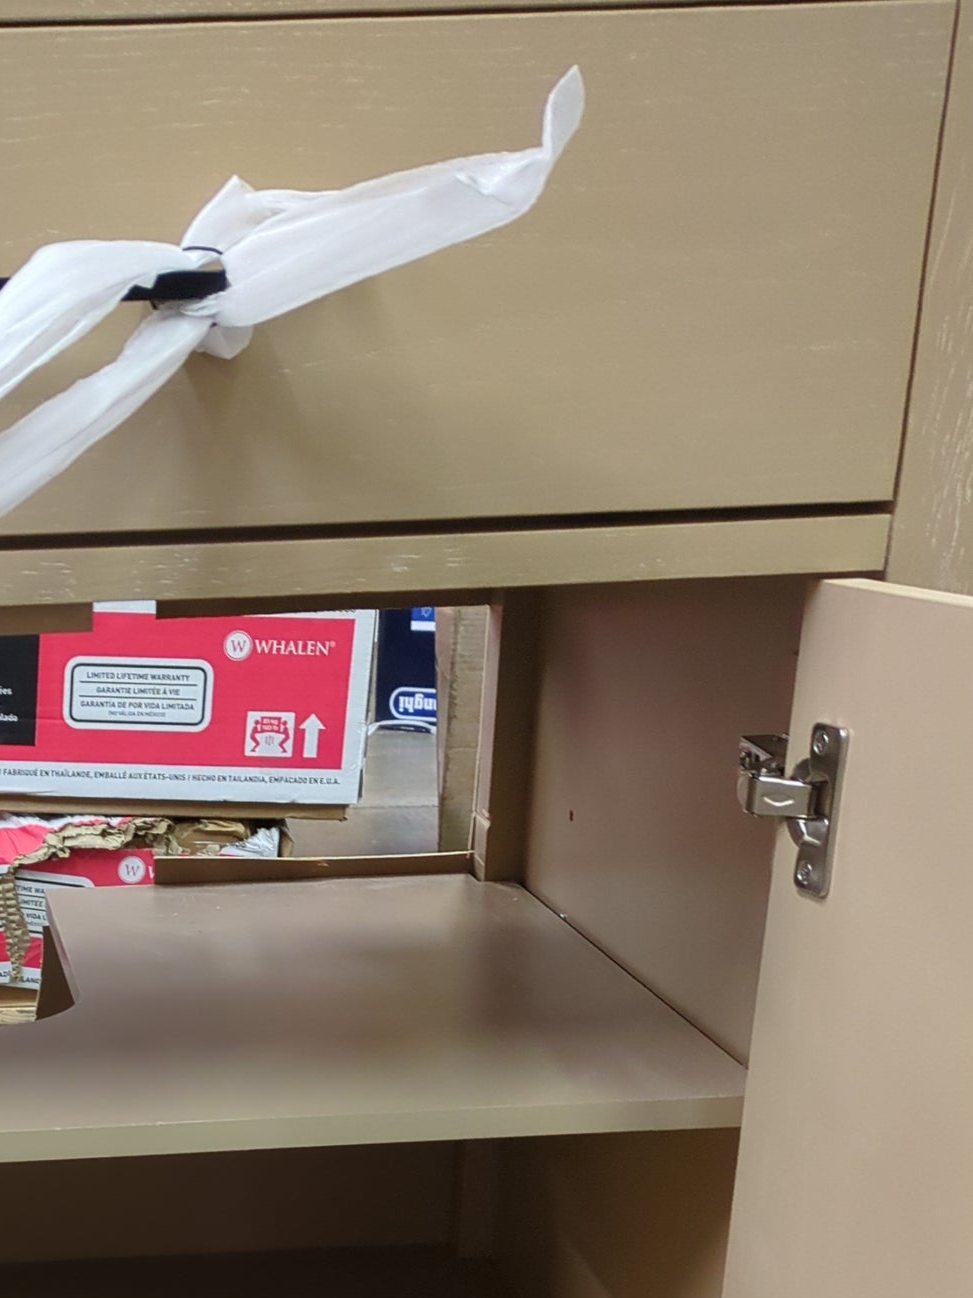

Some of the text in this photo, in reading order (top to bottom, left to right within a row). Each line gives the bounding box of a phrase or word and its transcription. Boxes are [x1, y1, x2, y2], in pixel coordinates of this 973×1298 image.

[86, 671, 190, 682] LIMITED LIFETIME WARRANTY
[96, 686, 131, 695] GARANTIE
[132, 686, 160, 695] LIMITÉE
[169, 688, 180, 696] VIE
[80, 700, 195, 711] GARANTÍA DE POR VIDA LIMITADA
[2, 767, 38, 777] FABRIQUÉ
[39, 769, 49, 777] EN
[94, 770, 127, 779] EMBALLÉ
[191, 774, 216, 782] HECHO
[268, 776, 308, 784] EMPACADO
[309, 777, 320, 785] EN
